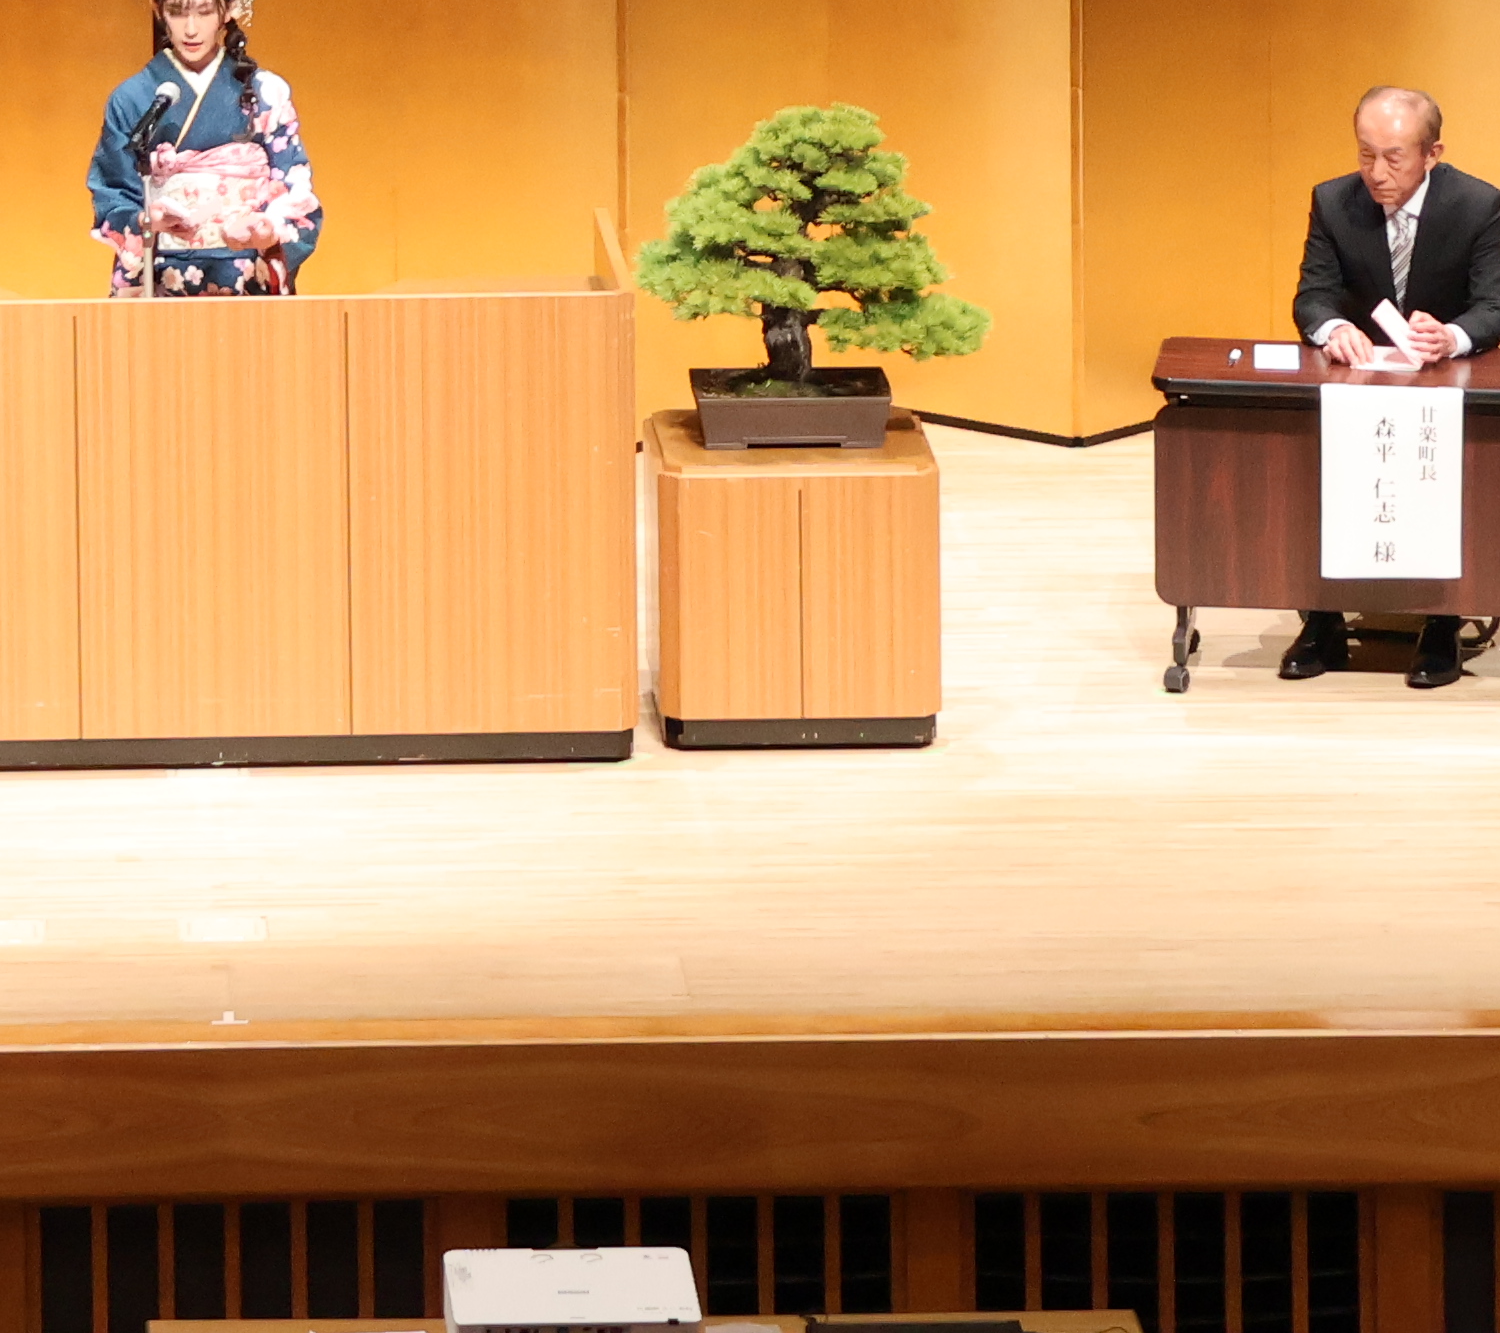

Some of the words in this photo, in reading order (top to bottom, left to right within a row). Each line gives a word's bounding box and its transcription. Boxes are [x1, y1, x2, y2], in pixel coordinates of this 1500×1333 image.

[1373, 416, 1396, 464] 森平
[1418, 405, 1438, 482] 甘楽町長
[1373, 477, 1396, 524] 仁志
[1373, 541, 1396, 563] 様
